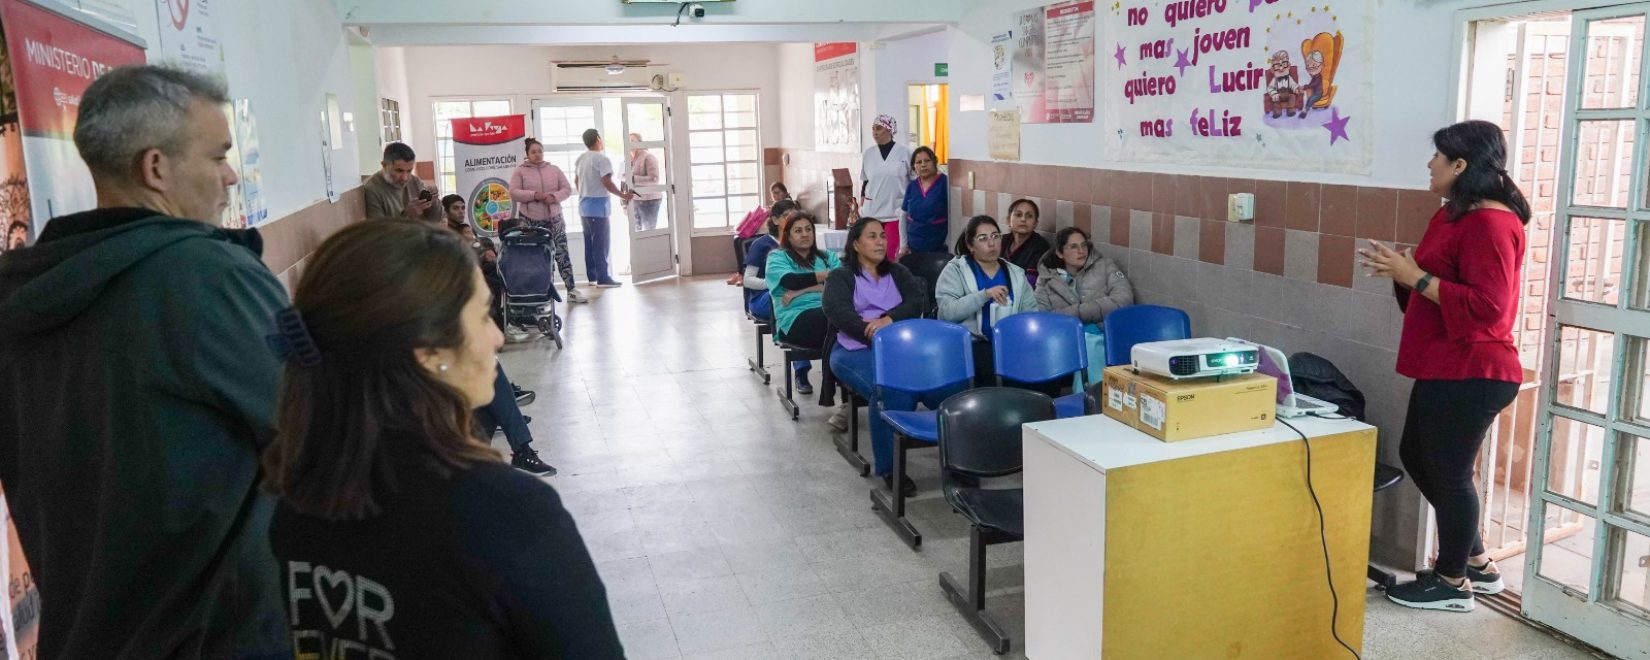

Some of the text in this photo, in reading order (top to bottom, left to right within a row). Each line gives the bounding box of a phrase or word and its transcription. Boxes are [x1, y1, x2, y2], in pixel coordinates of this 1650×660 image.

[1127, 7, 1149, 26] no
[1164, 0, 1227, 28] quiero
[25, 37, 91, 80] MINISTERIO
[1139, 26, 1251, 66] mas joven
[1124, 61, 1264, 104] quiero Lucir
[1140, 107, 1242, 137] mas feLiz
[464, 154, 517, 167] ALIMENTACIÓN
[1177, 394, 1195, 402] EPSON
